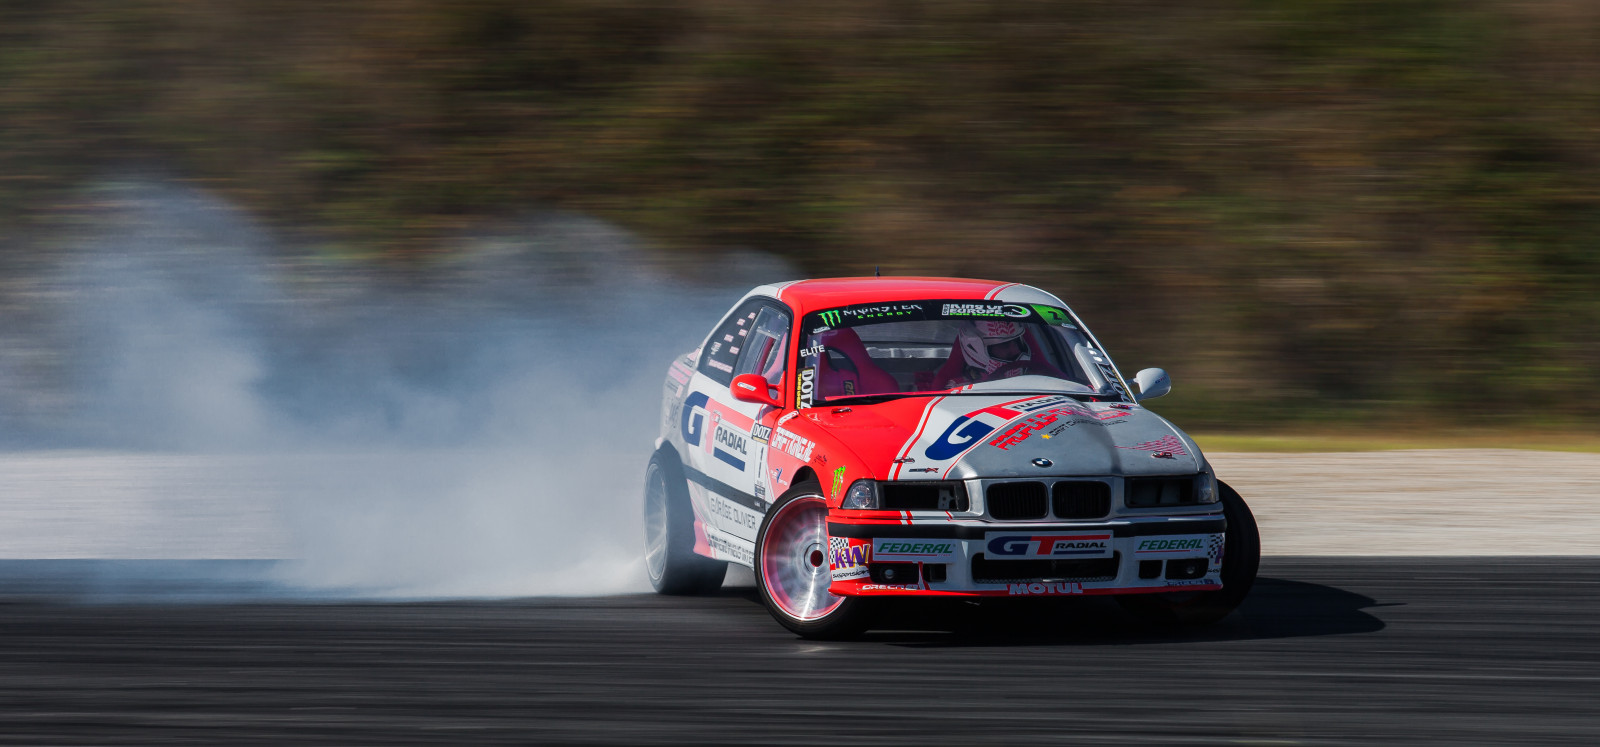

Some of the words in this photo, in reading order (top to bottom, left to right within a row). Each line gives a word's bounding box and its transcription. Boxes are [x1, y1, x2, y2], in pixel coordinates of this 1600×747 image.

[800, 344, 826, 357] ELITE
[800, 369, 814, 410] DOTZ
[752, 424, 772, 441] DOTZ
[715, 425, 748, 456] RADIAL
[878, 542, 953, 554] FEDERAL
[1055, 541, 1107, 549] RADIAL
[1138, 539, 1204, 550] FEDERAL
[834, 544, 871, 570] KW
[1008, 582, 1084, 595] MOTUL
